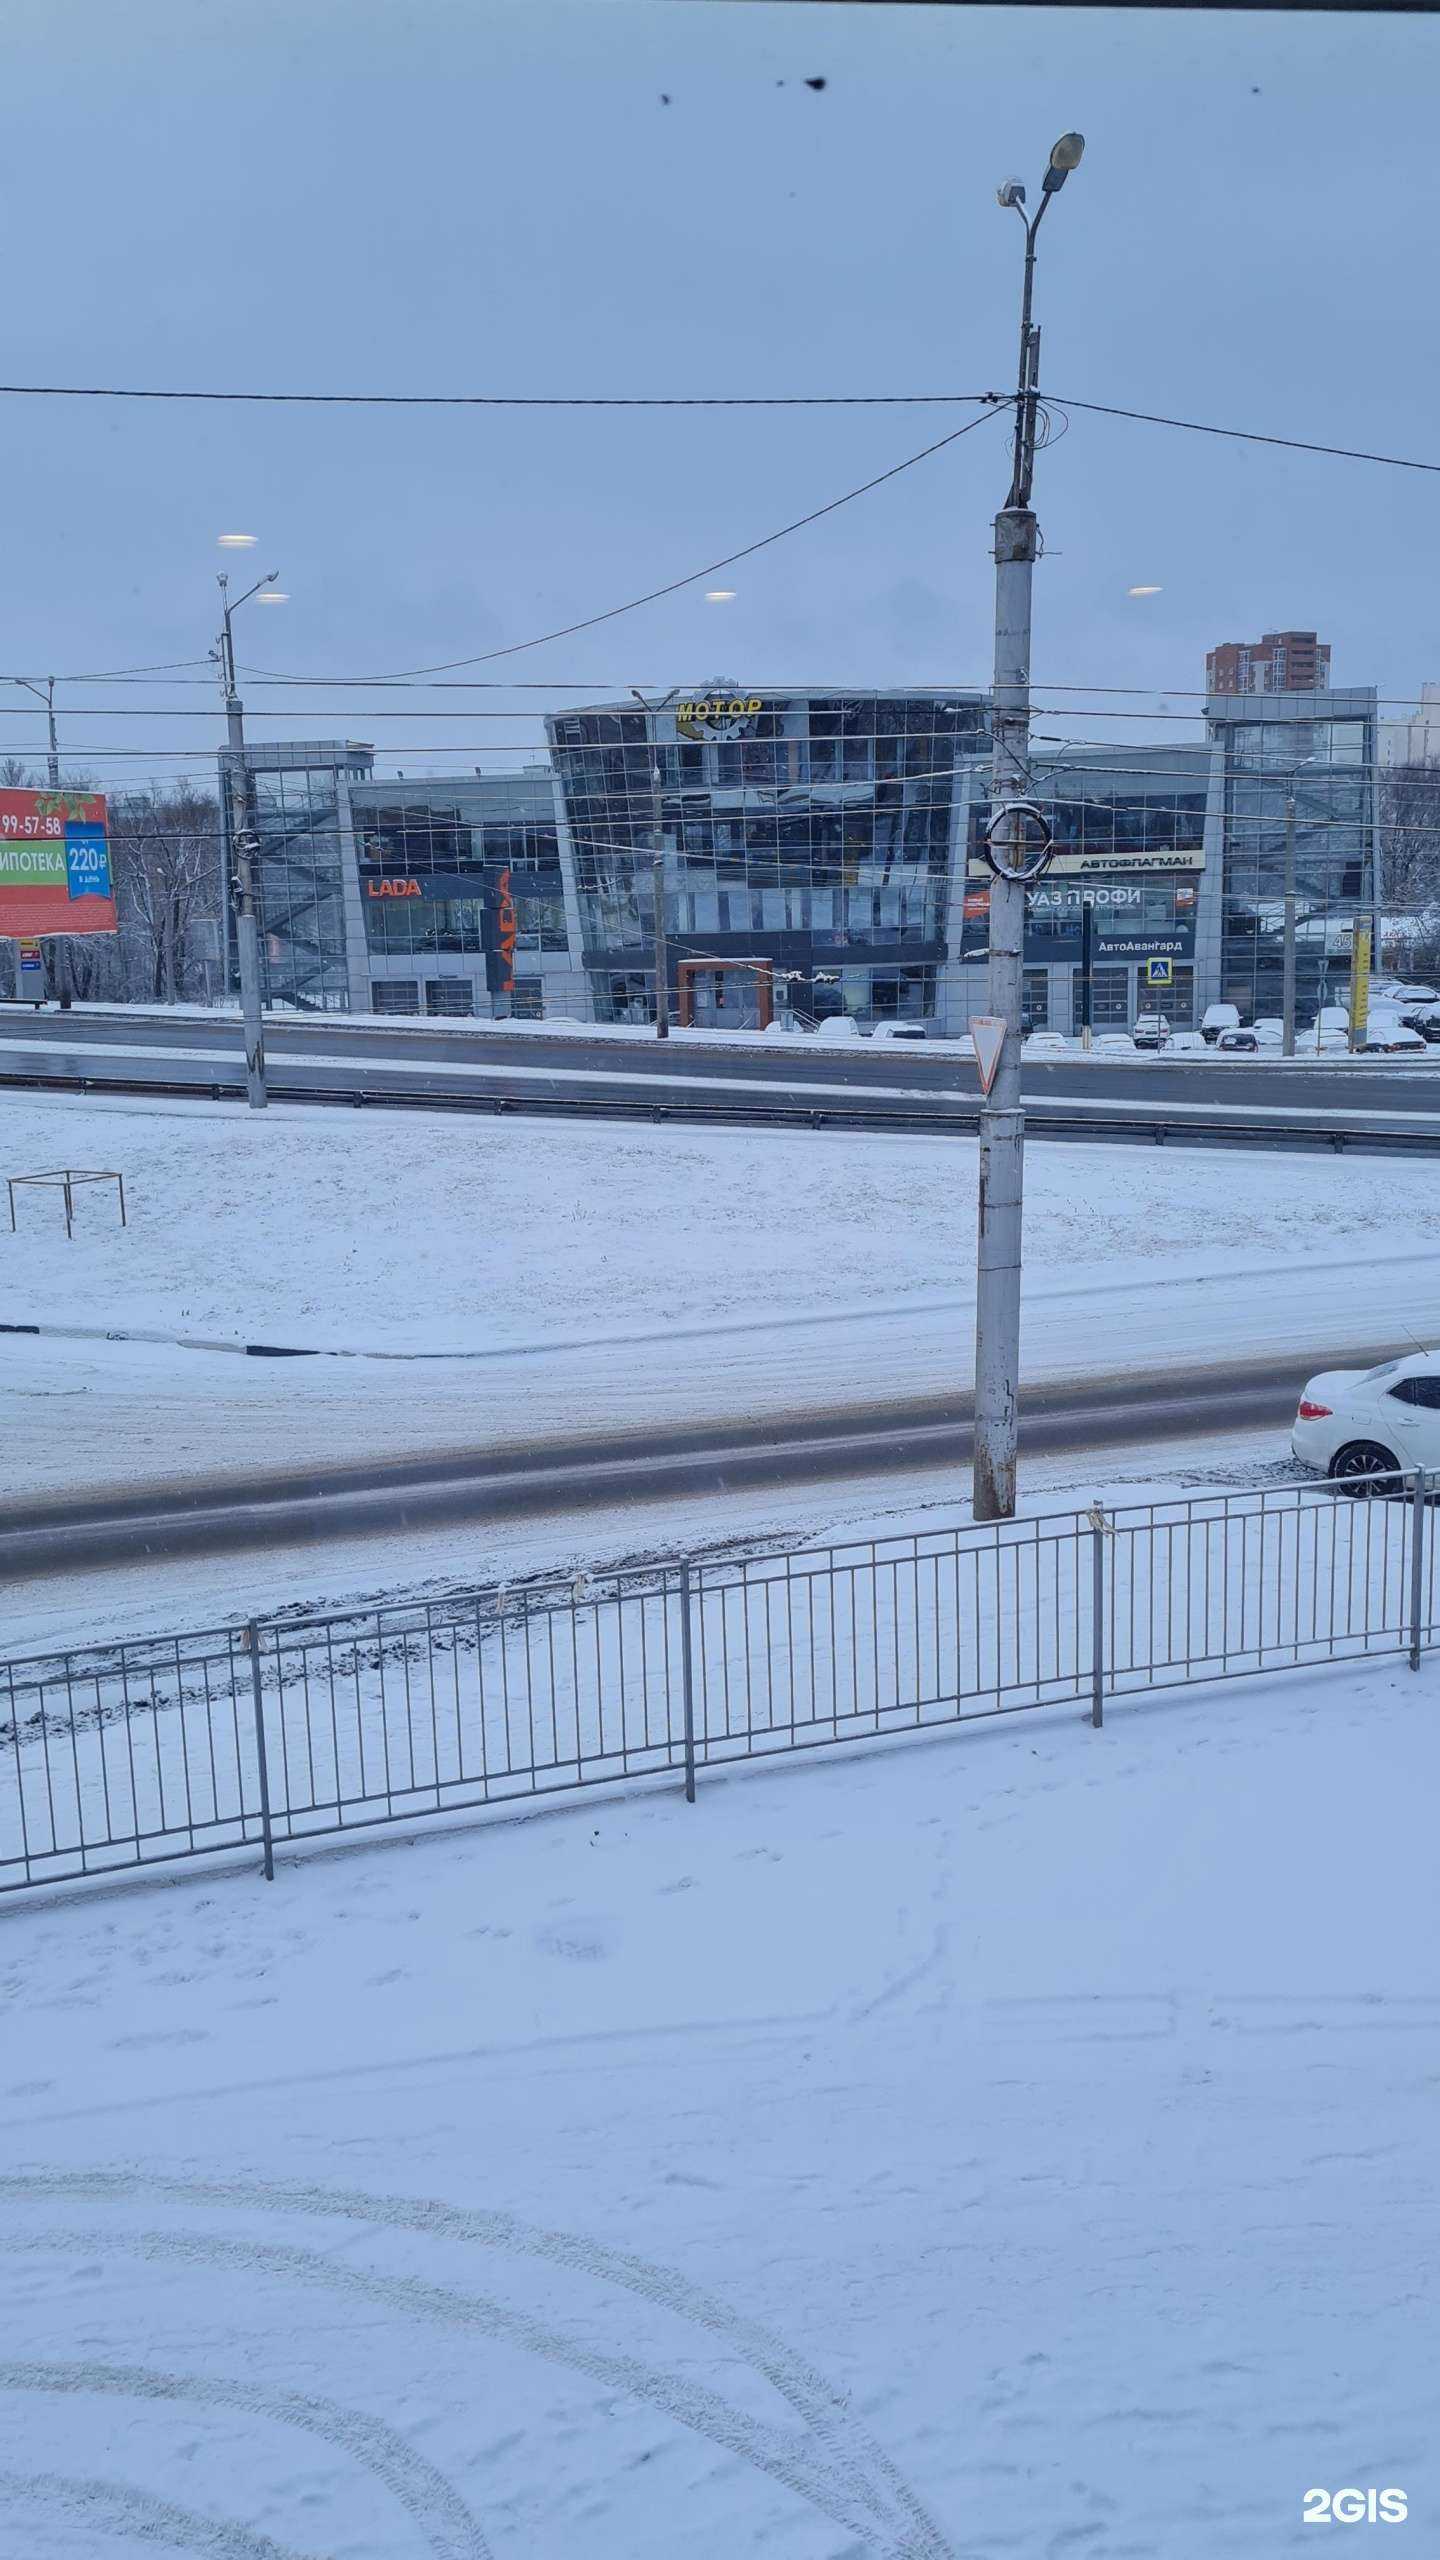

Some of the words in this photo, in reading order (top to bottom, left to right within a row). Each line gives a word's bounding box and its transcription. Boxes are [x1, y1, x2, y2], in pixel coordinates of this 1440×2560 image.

[677, 698, 762, 722] МОТОР
[2, 815, 61, 834] 99-57-58
[1080, 856, 1193, 869] АВТОФЛАГМАН
[368, 879, 422, 896] LADA
[1026, 891, 1062, 906] УАЗ
[1098, 941, 1183, 952] АвтоАвангард
